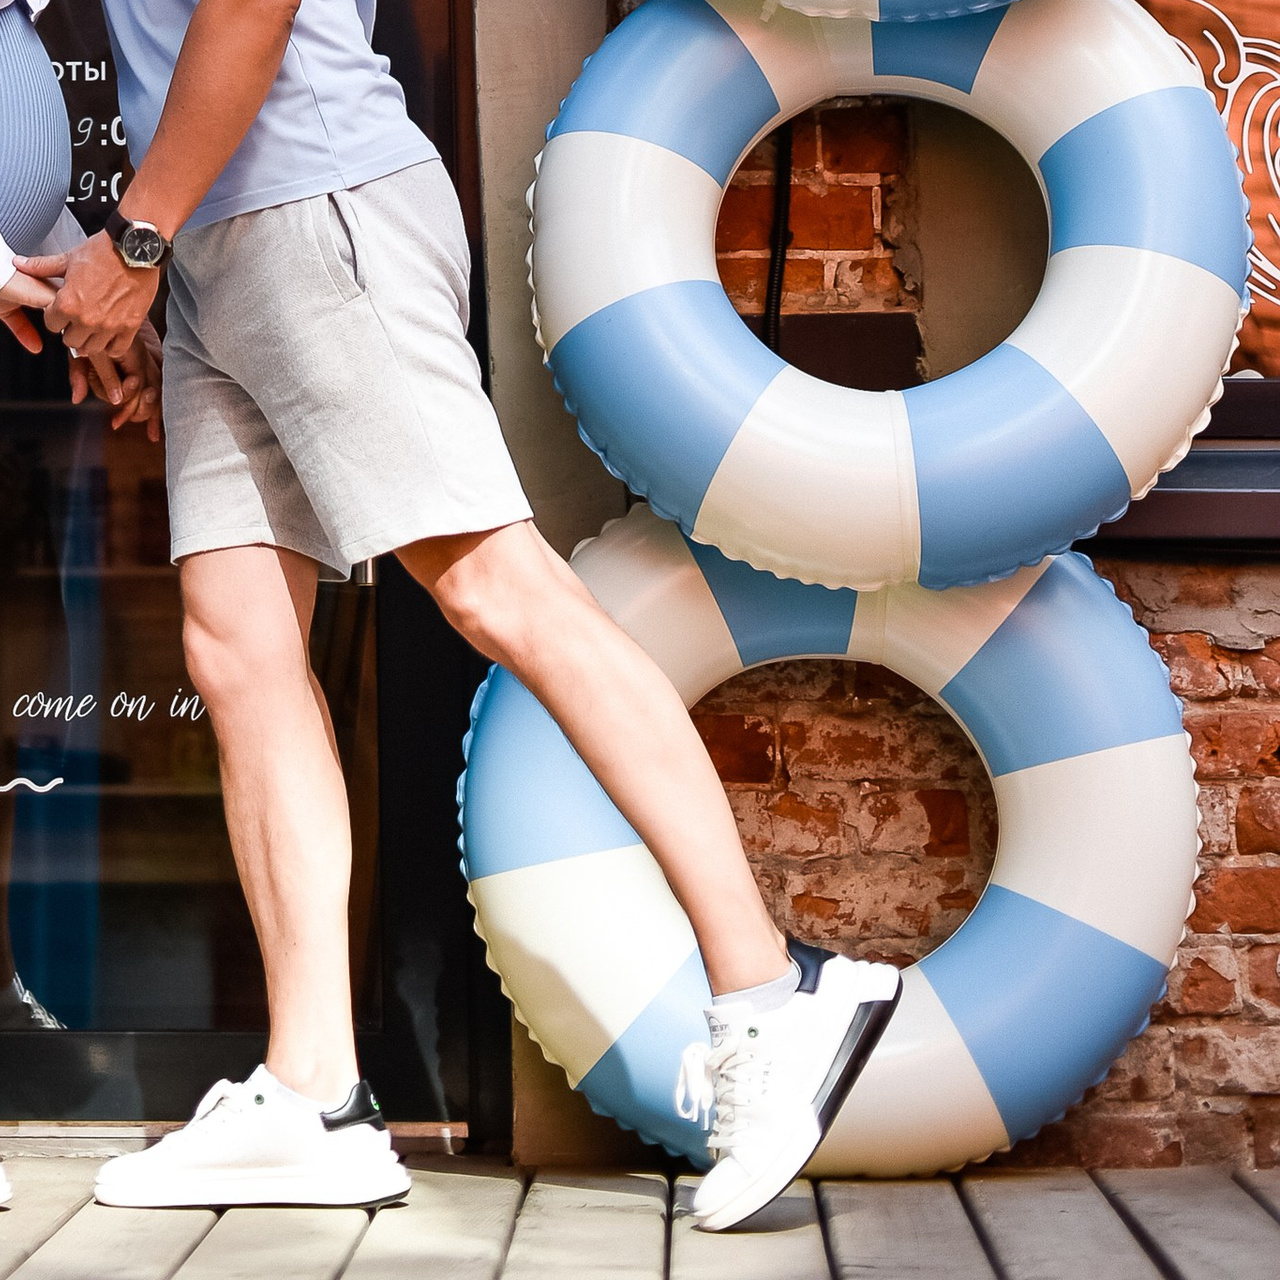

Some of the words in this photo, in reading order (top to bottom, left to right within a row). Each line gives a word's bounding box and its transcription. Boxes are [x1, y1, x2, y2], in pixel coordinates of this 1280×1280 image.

[12, 691, 98, 722] come
[110, 691, 156, 722] on
[169, 687, 207, 722] in
